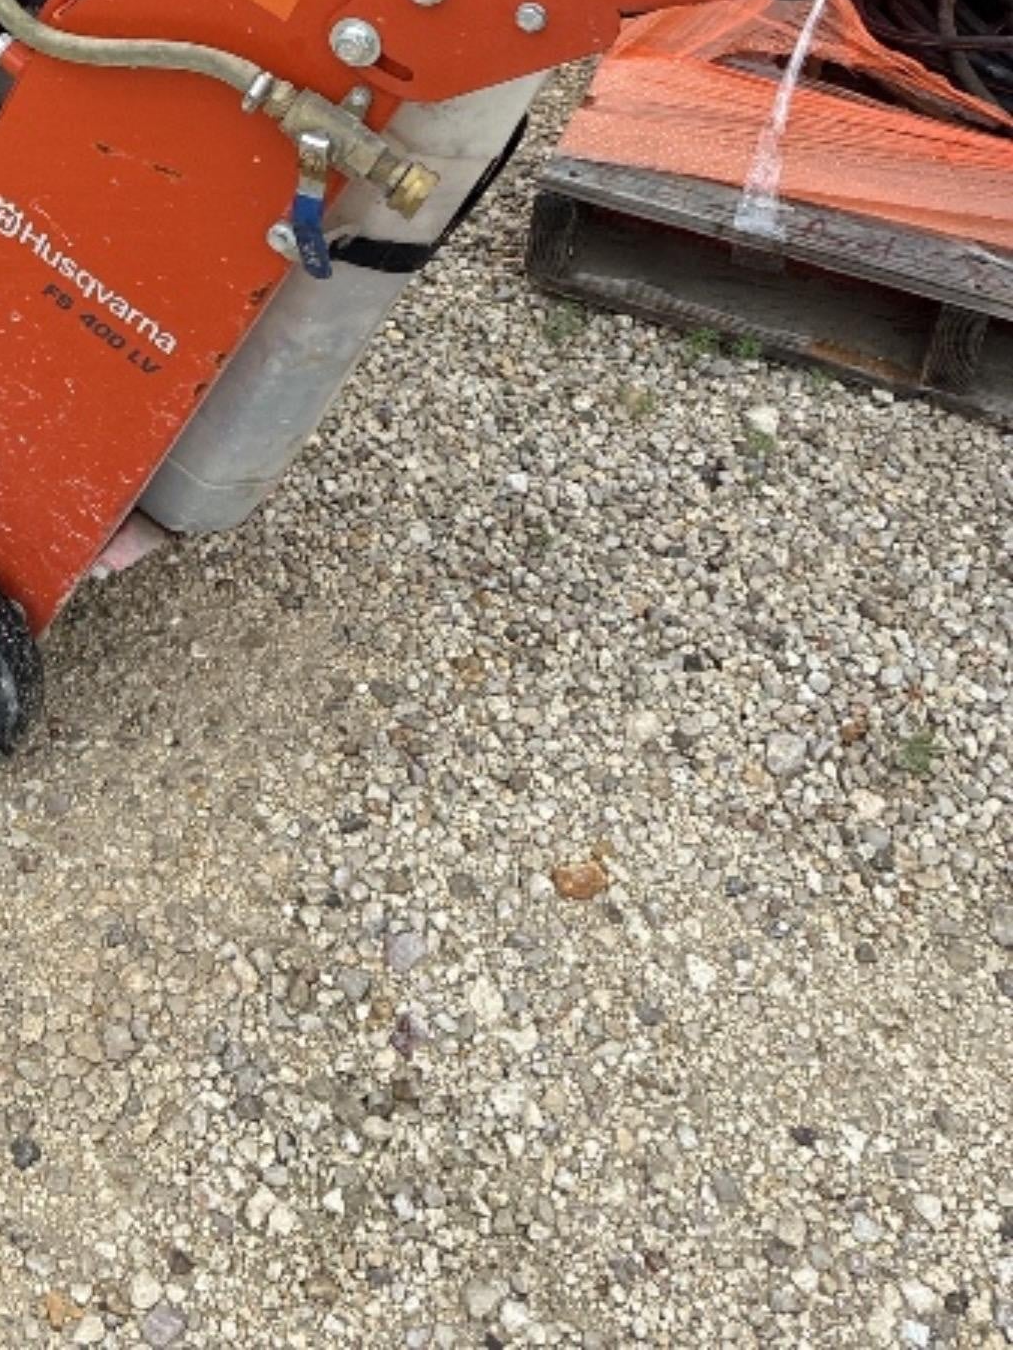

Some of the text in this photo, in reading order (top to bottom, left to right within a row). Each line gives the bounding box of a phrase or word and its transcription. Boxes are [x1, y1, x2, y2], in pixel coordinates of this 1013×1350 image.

[19, 220, 178, 355] Husqvarna
[79, 312, 127, 351] 400
[126, 349, 163, 375] LV
